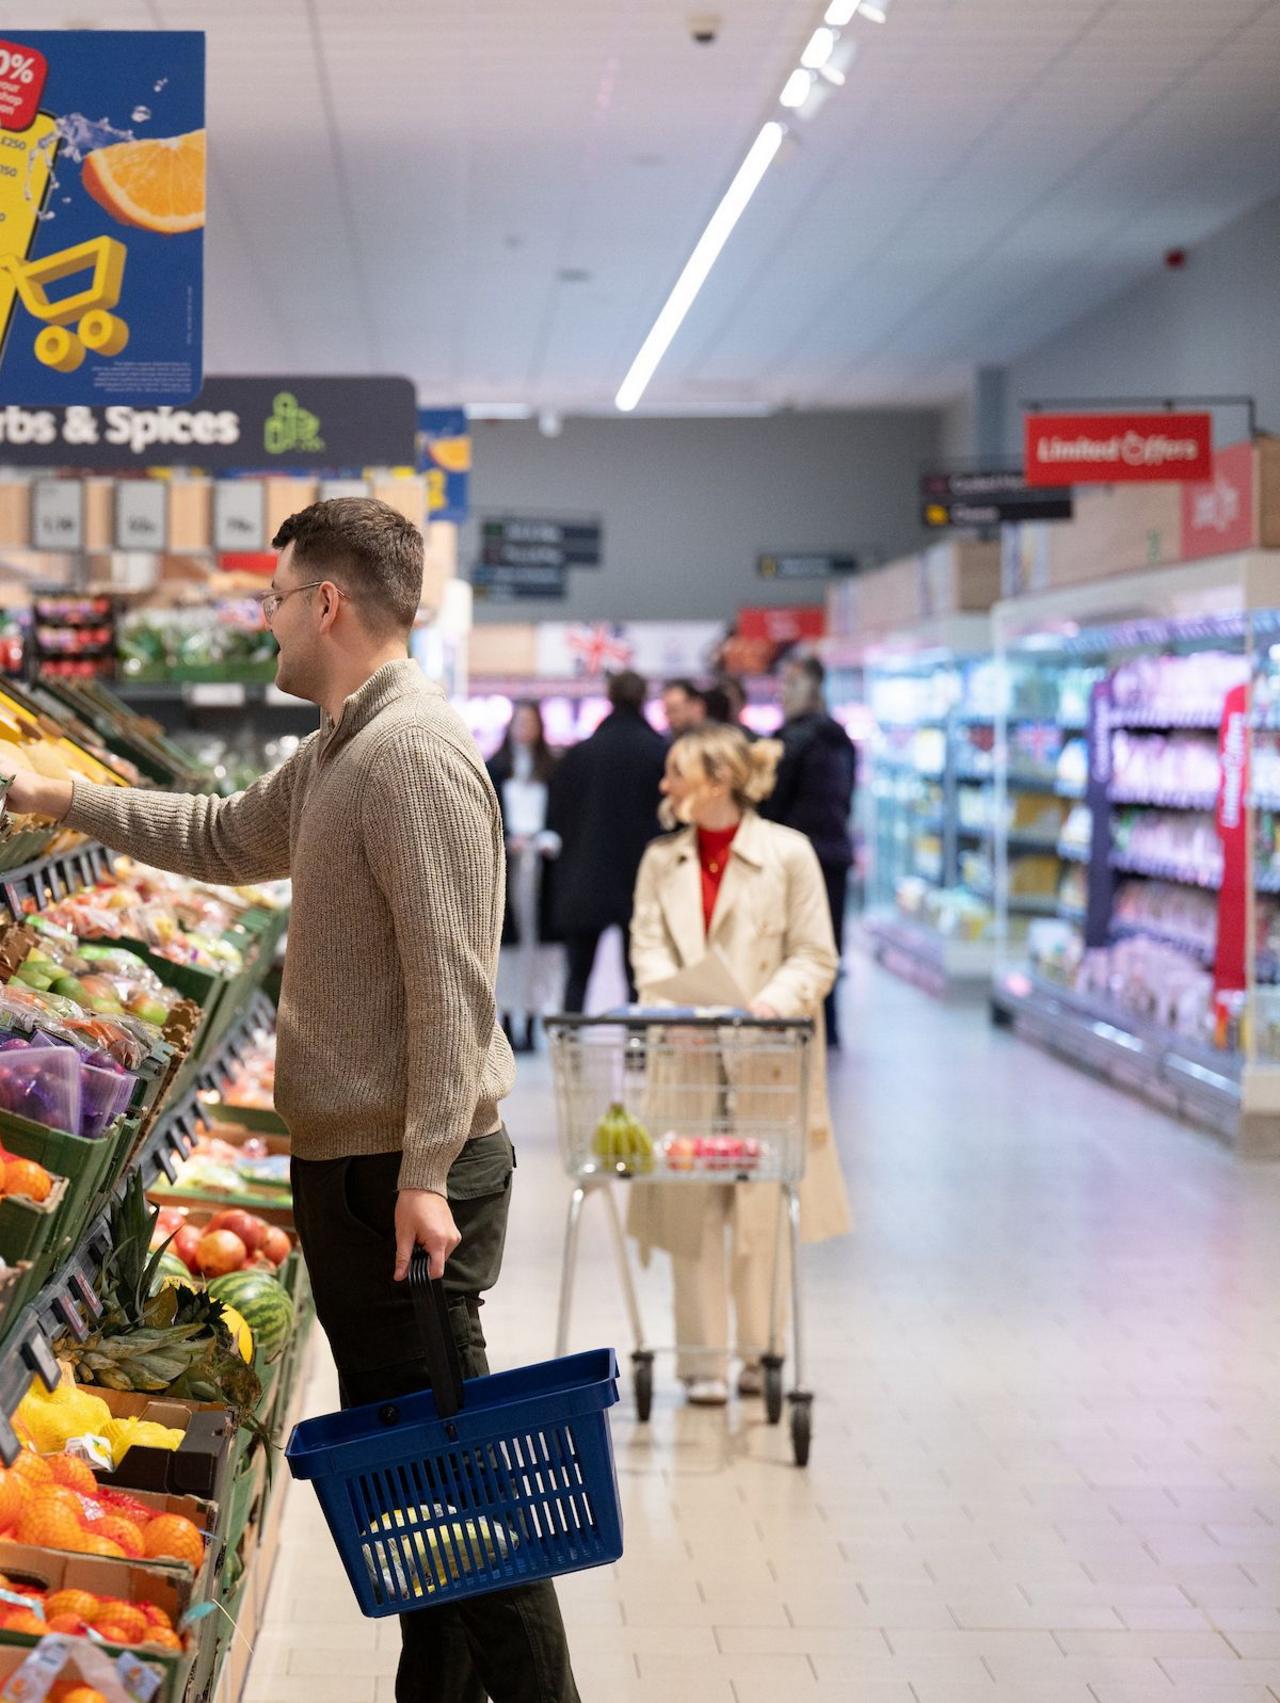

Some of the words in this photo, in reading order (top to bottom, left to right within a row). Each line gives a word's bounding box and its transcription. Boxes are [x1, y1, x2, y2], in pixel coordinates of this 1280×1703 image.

[0, 136, 26, 151] £250
[62, 406, 99, 444] &
[104, 406, 241, 454] Spices
[1036, 434, 1119, 463] Limited
